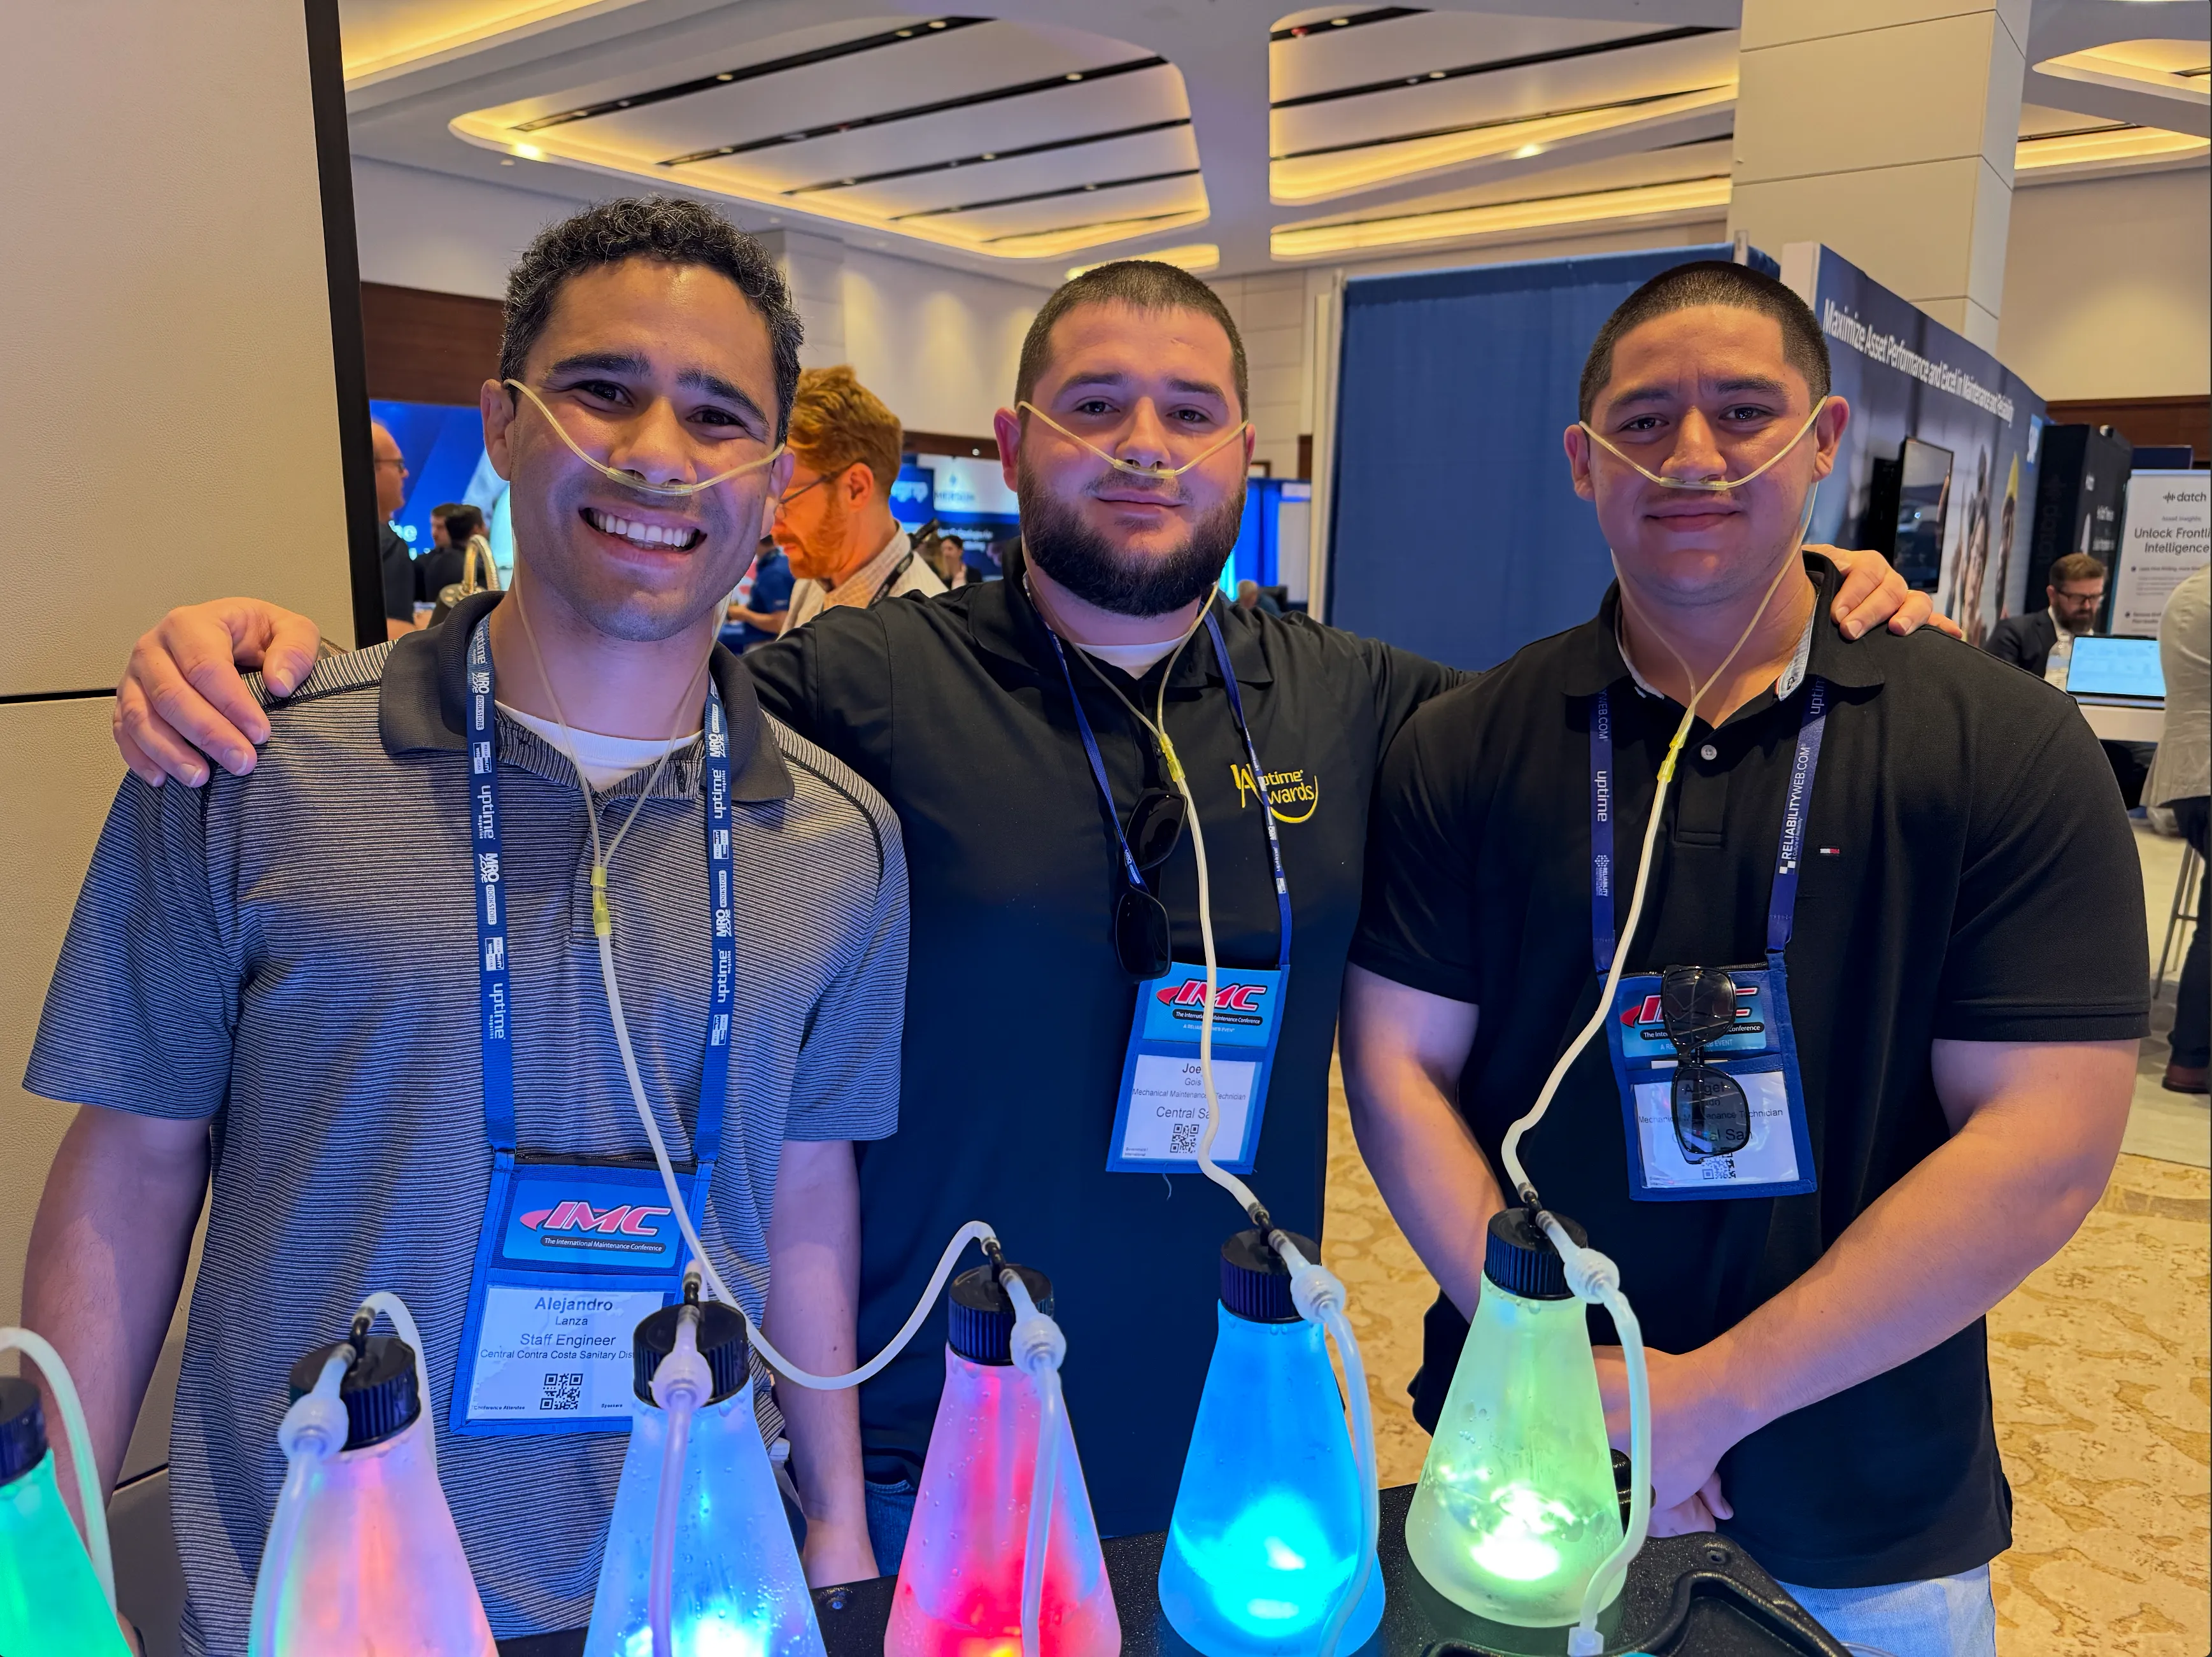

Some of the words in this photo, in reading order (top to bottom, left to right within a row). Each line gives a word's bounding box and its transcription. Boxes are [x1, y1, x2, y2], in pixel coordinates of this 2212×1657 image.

[1822, 297, 1867, 352] Maximize
[1864, 324, 1889, 364] Asset
[1887, 334, 1930, 383] Performance
[2177, 492, 2207, 502] datch
[2134, 527, 2173, 539] Unlock
[2145, 543, 2210, 555] Intelligence
[474, 627, 486, 664] uptime
[478, 672, 490, 694] MRO
[1810, 677, 1825, 714] uptim
[709, 733, 720, 758] MRO
[712, 769, 727, 819] uptime
[1594, 771, 1610, 821] uptime
[478, 785, 494, 839] uptime
[486, 853, 499, 883] MRO
[716, 909, 727, 937] MRO
[718, 950, 730, 1003] uptime
[489, 983, 506, 1039] uptime
[1182, 1063, 1202, 1077] Joe
[1132, 1088, 1168, 1097] Mechanical
[1684, 1082, 1725, 1095] Agel
[1156, 1107, 1196, 1118] Central
[1739, 1109, 1783, 1118] Tchnician
[542, 1200, 672, 1236] IMC
[557, 1239, 593, 1247] International
[593, 1241, 630, 1249] Maintenance
[535, 1297, 613, 1313] Alejandro
[555, 1316, 588, 1325] Lanza
[520, 1333, 553, 1346] Staff
[556, 1334, 616, 1348] Engineer
[480, 1349, 514, 1358] Central
[517, 1350, 548, 1359] Contra
[551, 1351, 577, 1359] Costa
[579, 1351, 616, 1361] Sanitary
